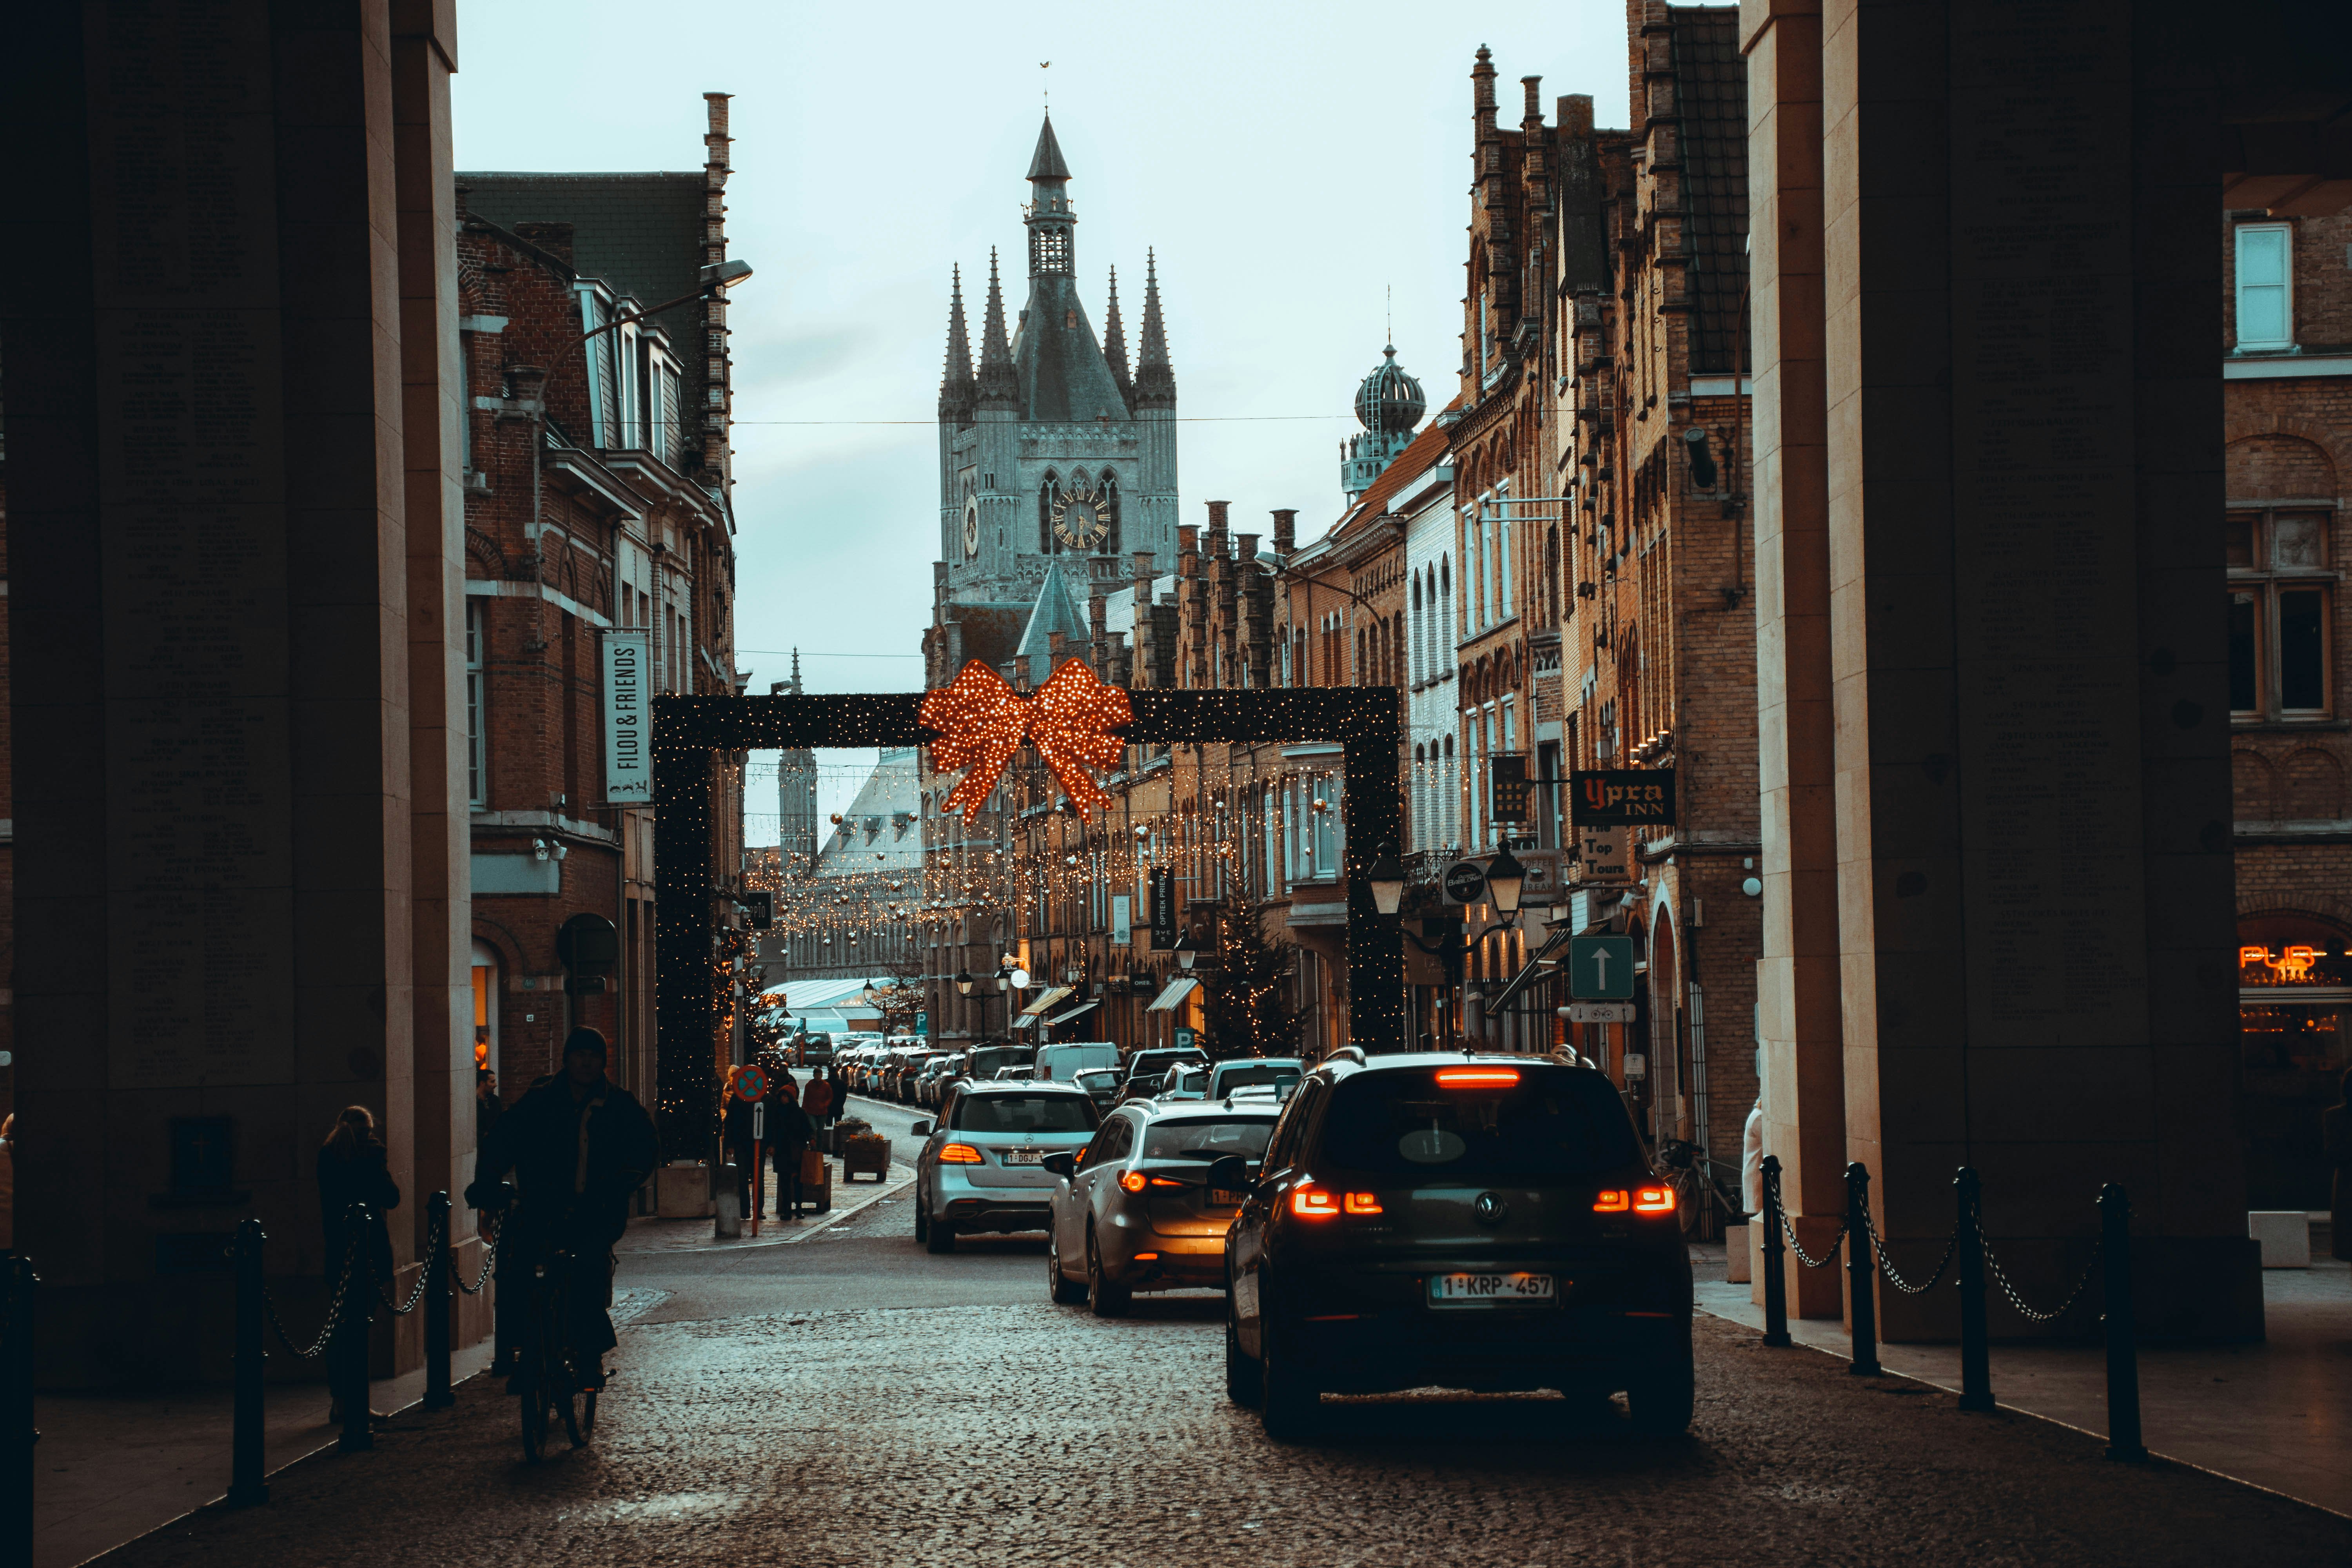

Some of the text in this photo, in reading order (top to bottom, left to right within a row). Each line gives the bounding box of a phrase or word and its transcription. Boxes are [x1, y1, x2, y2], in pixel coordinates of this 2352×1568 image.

[614, 648, 638, 769] FILOU & FRIENDS
[1584, 778, 1664, 810] Ypra
[1625, 803, 1664, 815] INN
[1585, 838, 1612, 855] Top
[1585, 860, 1624, 874] Tours
[2239, 946, 2315, 969] PUB
[917, 1013, 926, 1026] P
[1178, 1033, 1192, 1048] P
